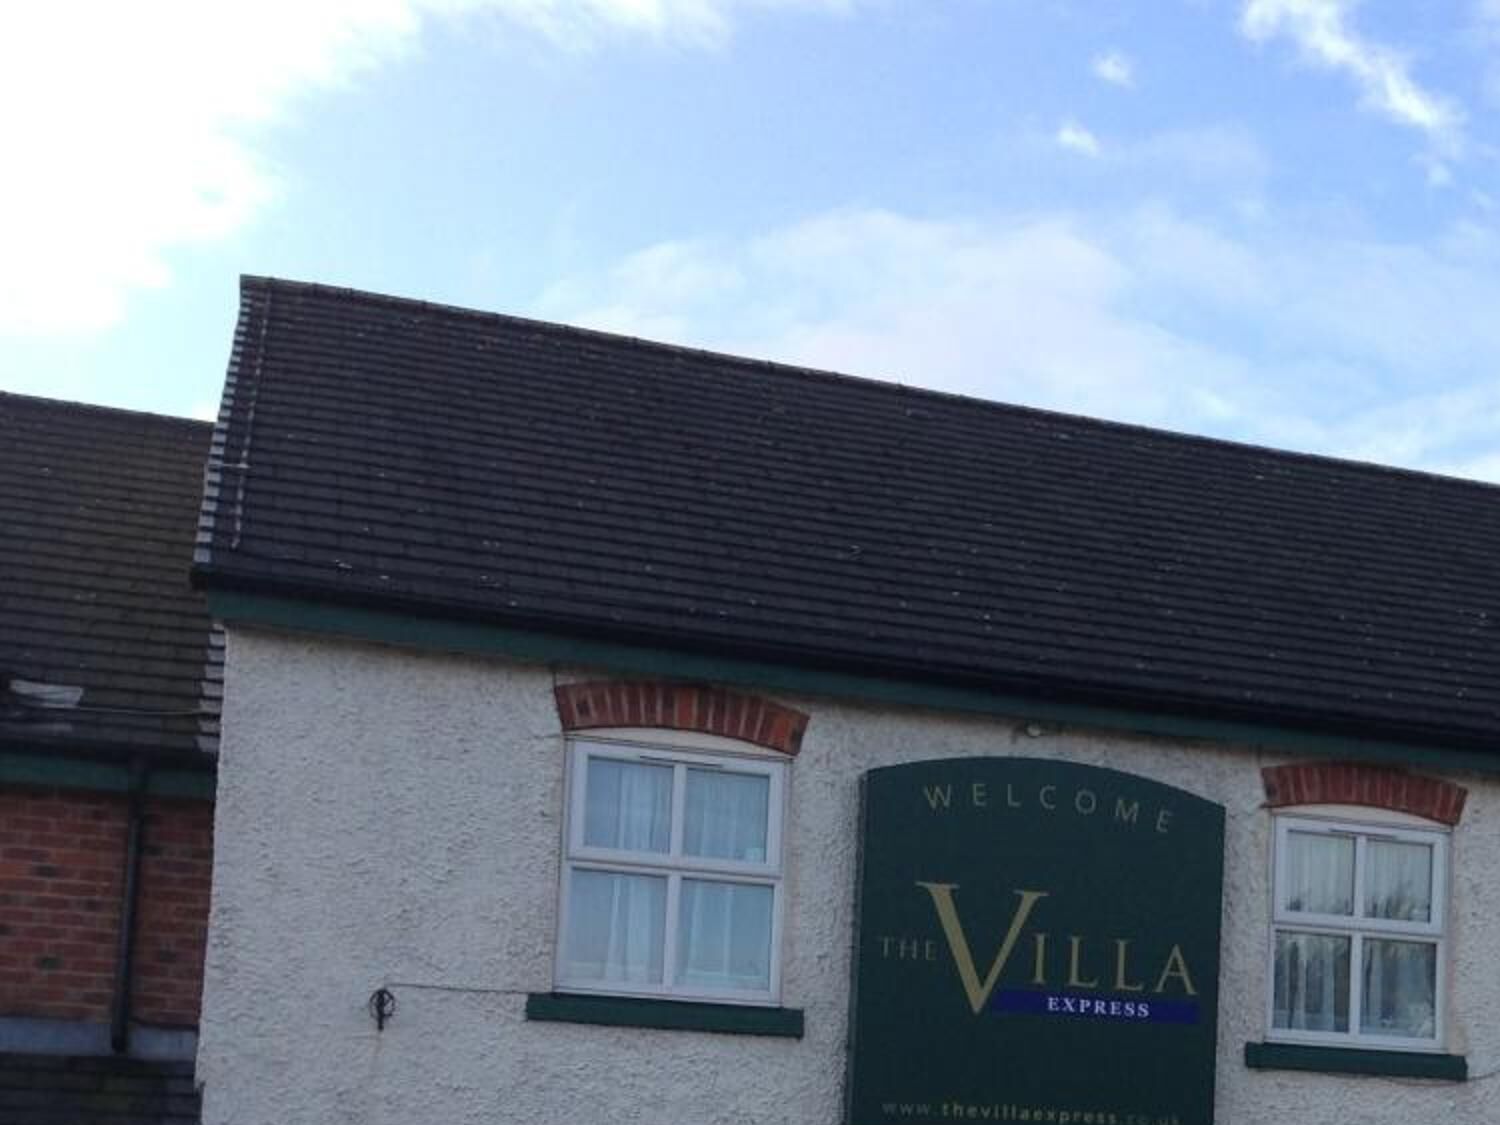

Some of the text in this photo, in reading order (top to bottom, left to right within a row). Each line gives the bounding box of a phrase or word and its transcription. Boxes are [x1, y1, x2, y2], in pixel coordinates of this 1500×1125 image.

[924, 783, 1173, 833] WELCOME
[879, 881, 1198, 1015] THE VILLA
[1047, 997, 1150, 1018] EXPRESS
